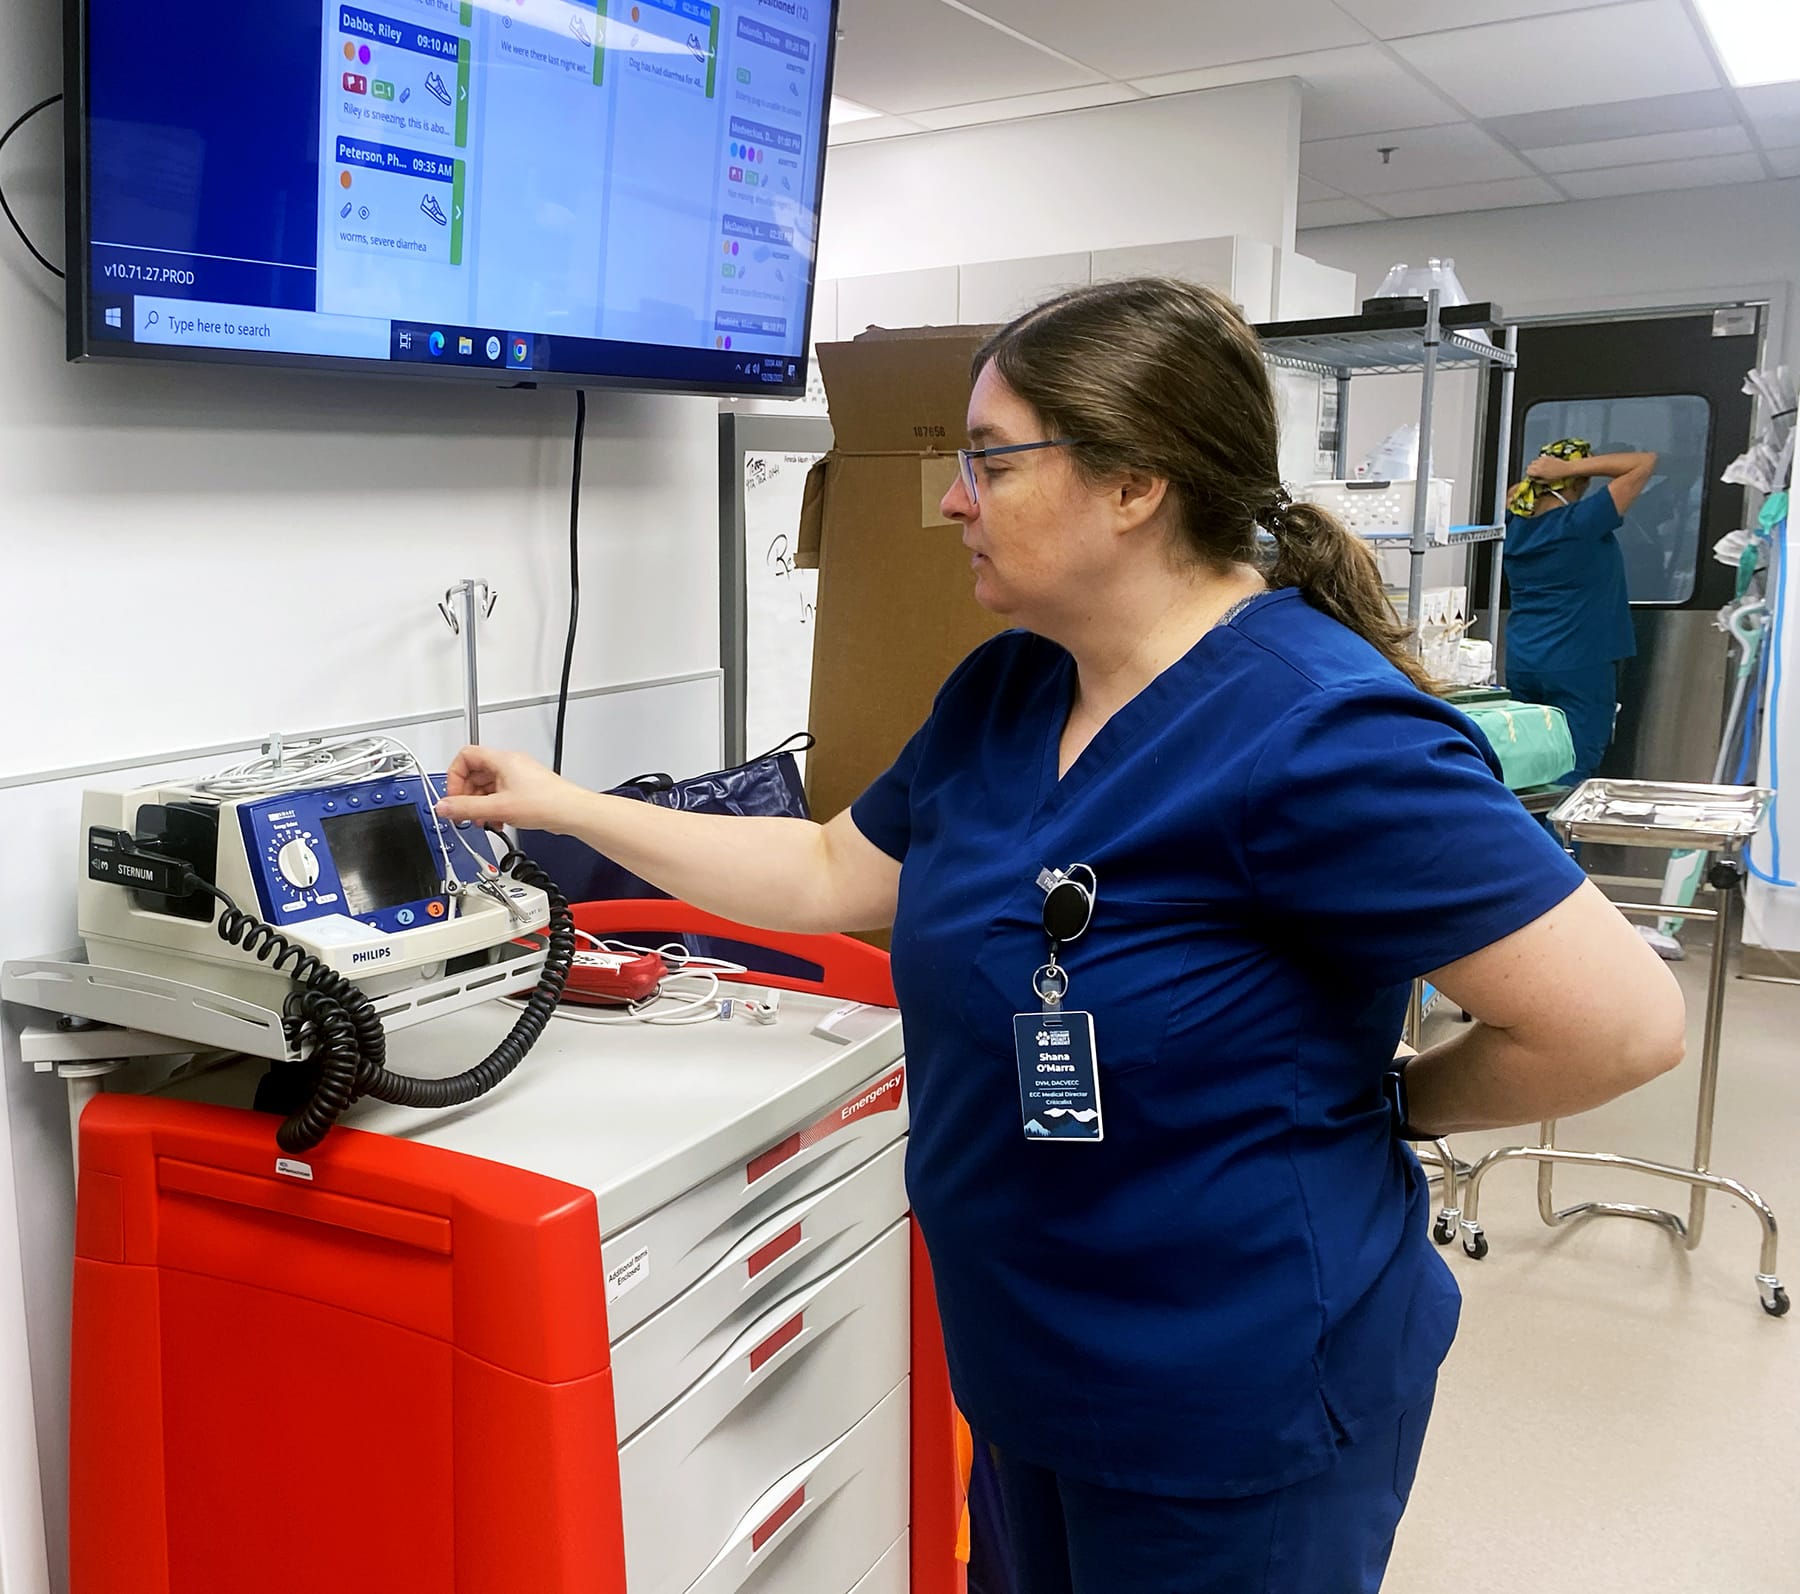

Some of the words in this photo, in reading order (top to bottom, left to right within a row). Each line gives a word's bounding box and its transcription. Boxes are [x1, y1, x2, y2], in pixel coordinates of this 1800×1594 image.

[343, 13, 376, 36] Dabbs,
[378, 23, 402, 44] Riley
[417, 34, 440, 51] 09:10
[442, 42, 457, 56] AM
[501, 40, 512, 52] We
[512, 47, 529, 57] were
[530, 49, 548, 62] there
[343, 102, 362, 119] Riley
[364, 107, 370, 117] is
[371, 110, 406, 129] sneezing,
[408, 118, 422, 130] this
[423, 121, 430, 130] is
[340, 144, 385, 166] Peterson,
[387, 153, 407, 168] Ph...
[412, 158, 436, 174] 09:35
[437, 164, 452, 177] AM
[340, 232, 369, 245] worms,
[370, 236, 394, 248] severe
[396, 238, 427, 252] diarrhea
[104, 263, 194, 286] v10.71.27.PROD
[169, 316, 194, 334] Type
[197, 318, 222, 334] here
[224, 321, 235, 334] to
[238, 322, 271, 338] search
[118, 864, 153, 880] STERNUM
[402, 911, 410, 922] 2
[432, 904, 440, 915] 3
[352, 947, 391, 964] PHILIPS
[1040, 1052, 1070, 1061] Shana
[1036, 1064, 1076, 1073] O'Marra
[841, 1074, 902, 1120] Emergency
[608, 1258, 634, 1283] Additional
[634, 1249, 648, 1263] Items
[618, 1262, 641, 1286] Enclosed
